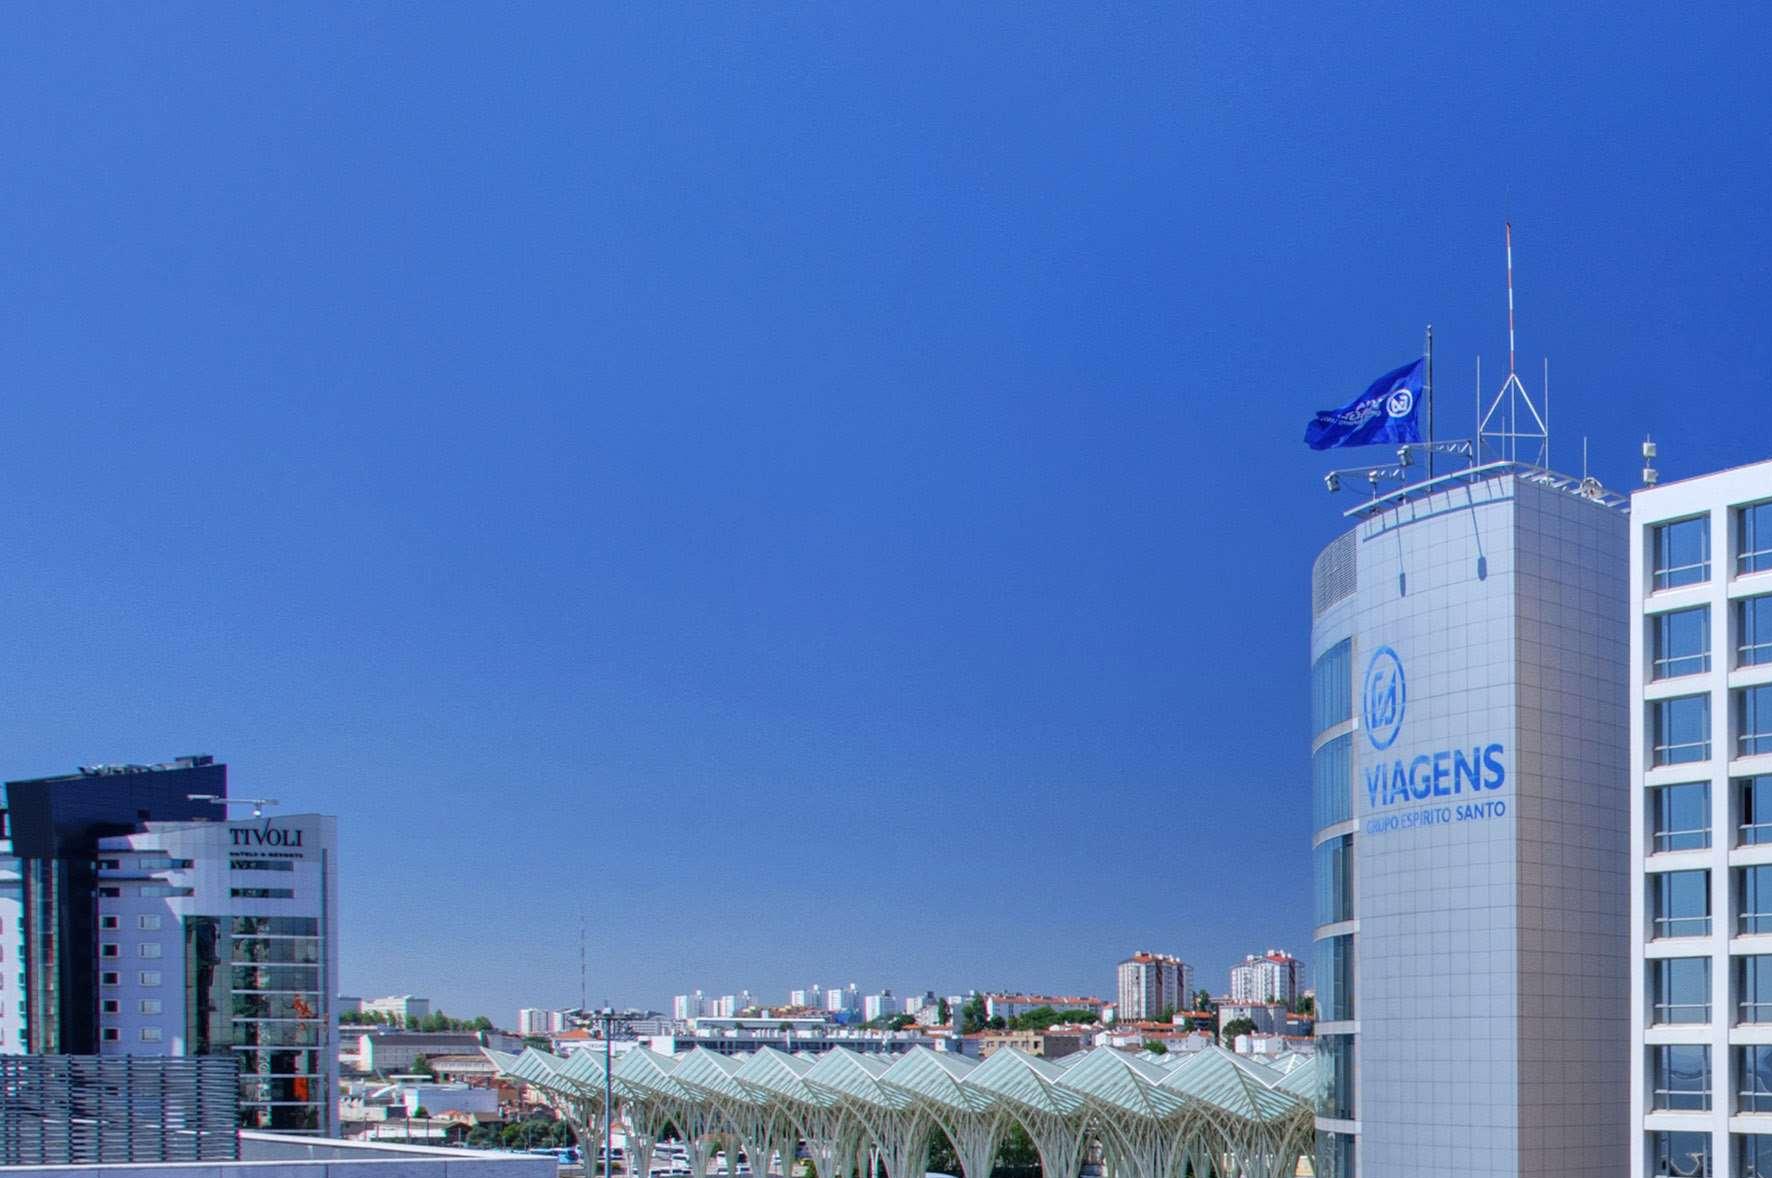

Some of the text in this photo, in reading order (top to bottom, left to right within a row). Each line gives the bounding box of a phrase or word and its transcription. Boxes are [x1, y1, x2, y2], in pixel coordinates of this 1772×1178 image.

[1365, 743, 1505, 808] VIAGENS
[229, 818, 303, 847] TIVOLI
[1367, 815, 1398, 834] GRUPO
[1455, 801, 1506, 821] SANTO
